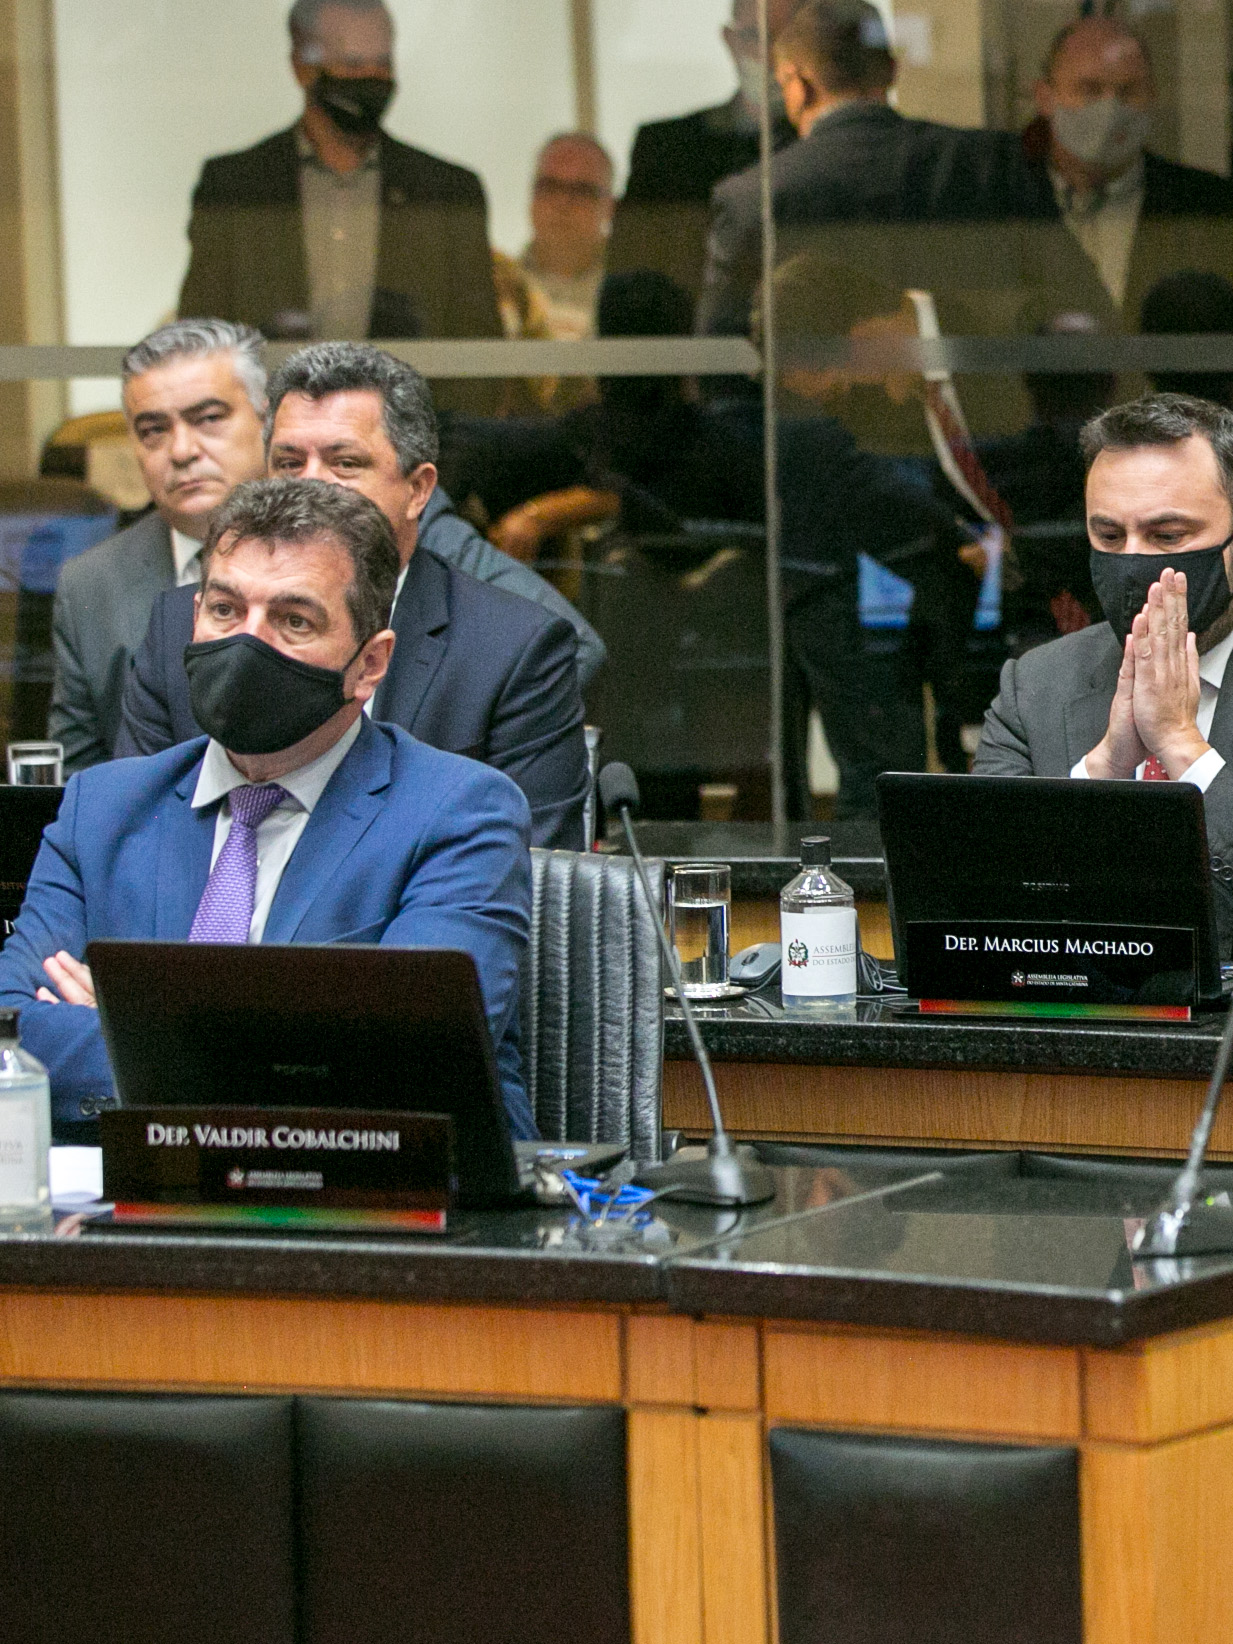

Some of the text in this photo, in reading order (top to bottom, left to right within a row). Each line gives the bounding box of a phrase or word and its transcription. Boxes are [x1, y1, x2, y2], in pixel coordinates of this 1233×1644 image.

[945, 934, 1154, 957] DEP. MARCIUS MACHADO
[826, 957, 849, 966] ESTADO
[146, 1122, 400, 1152] DEP. VALDIR COBALCHINI
